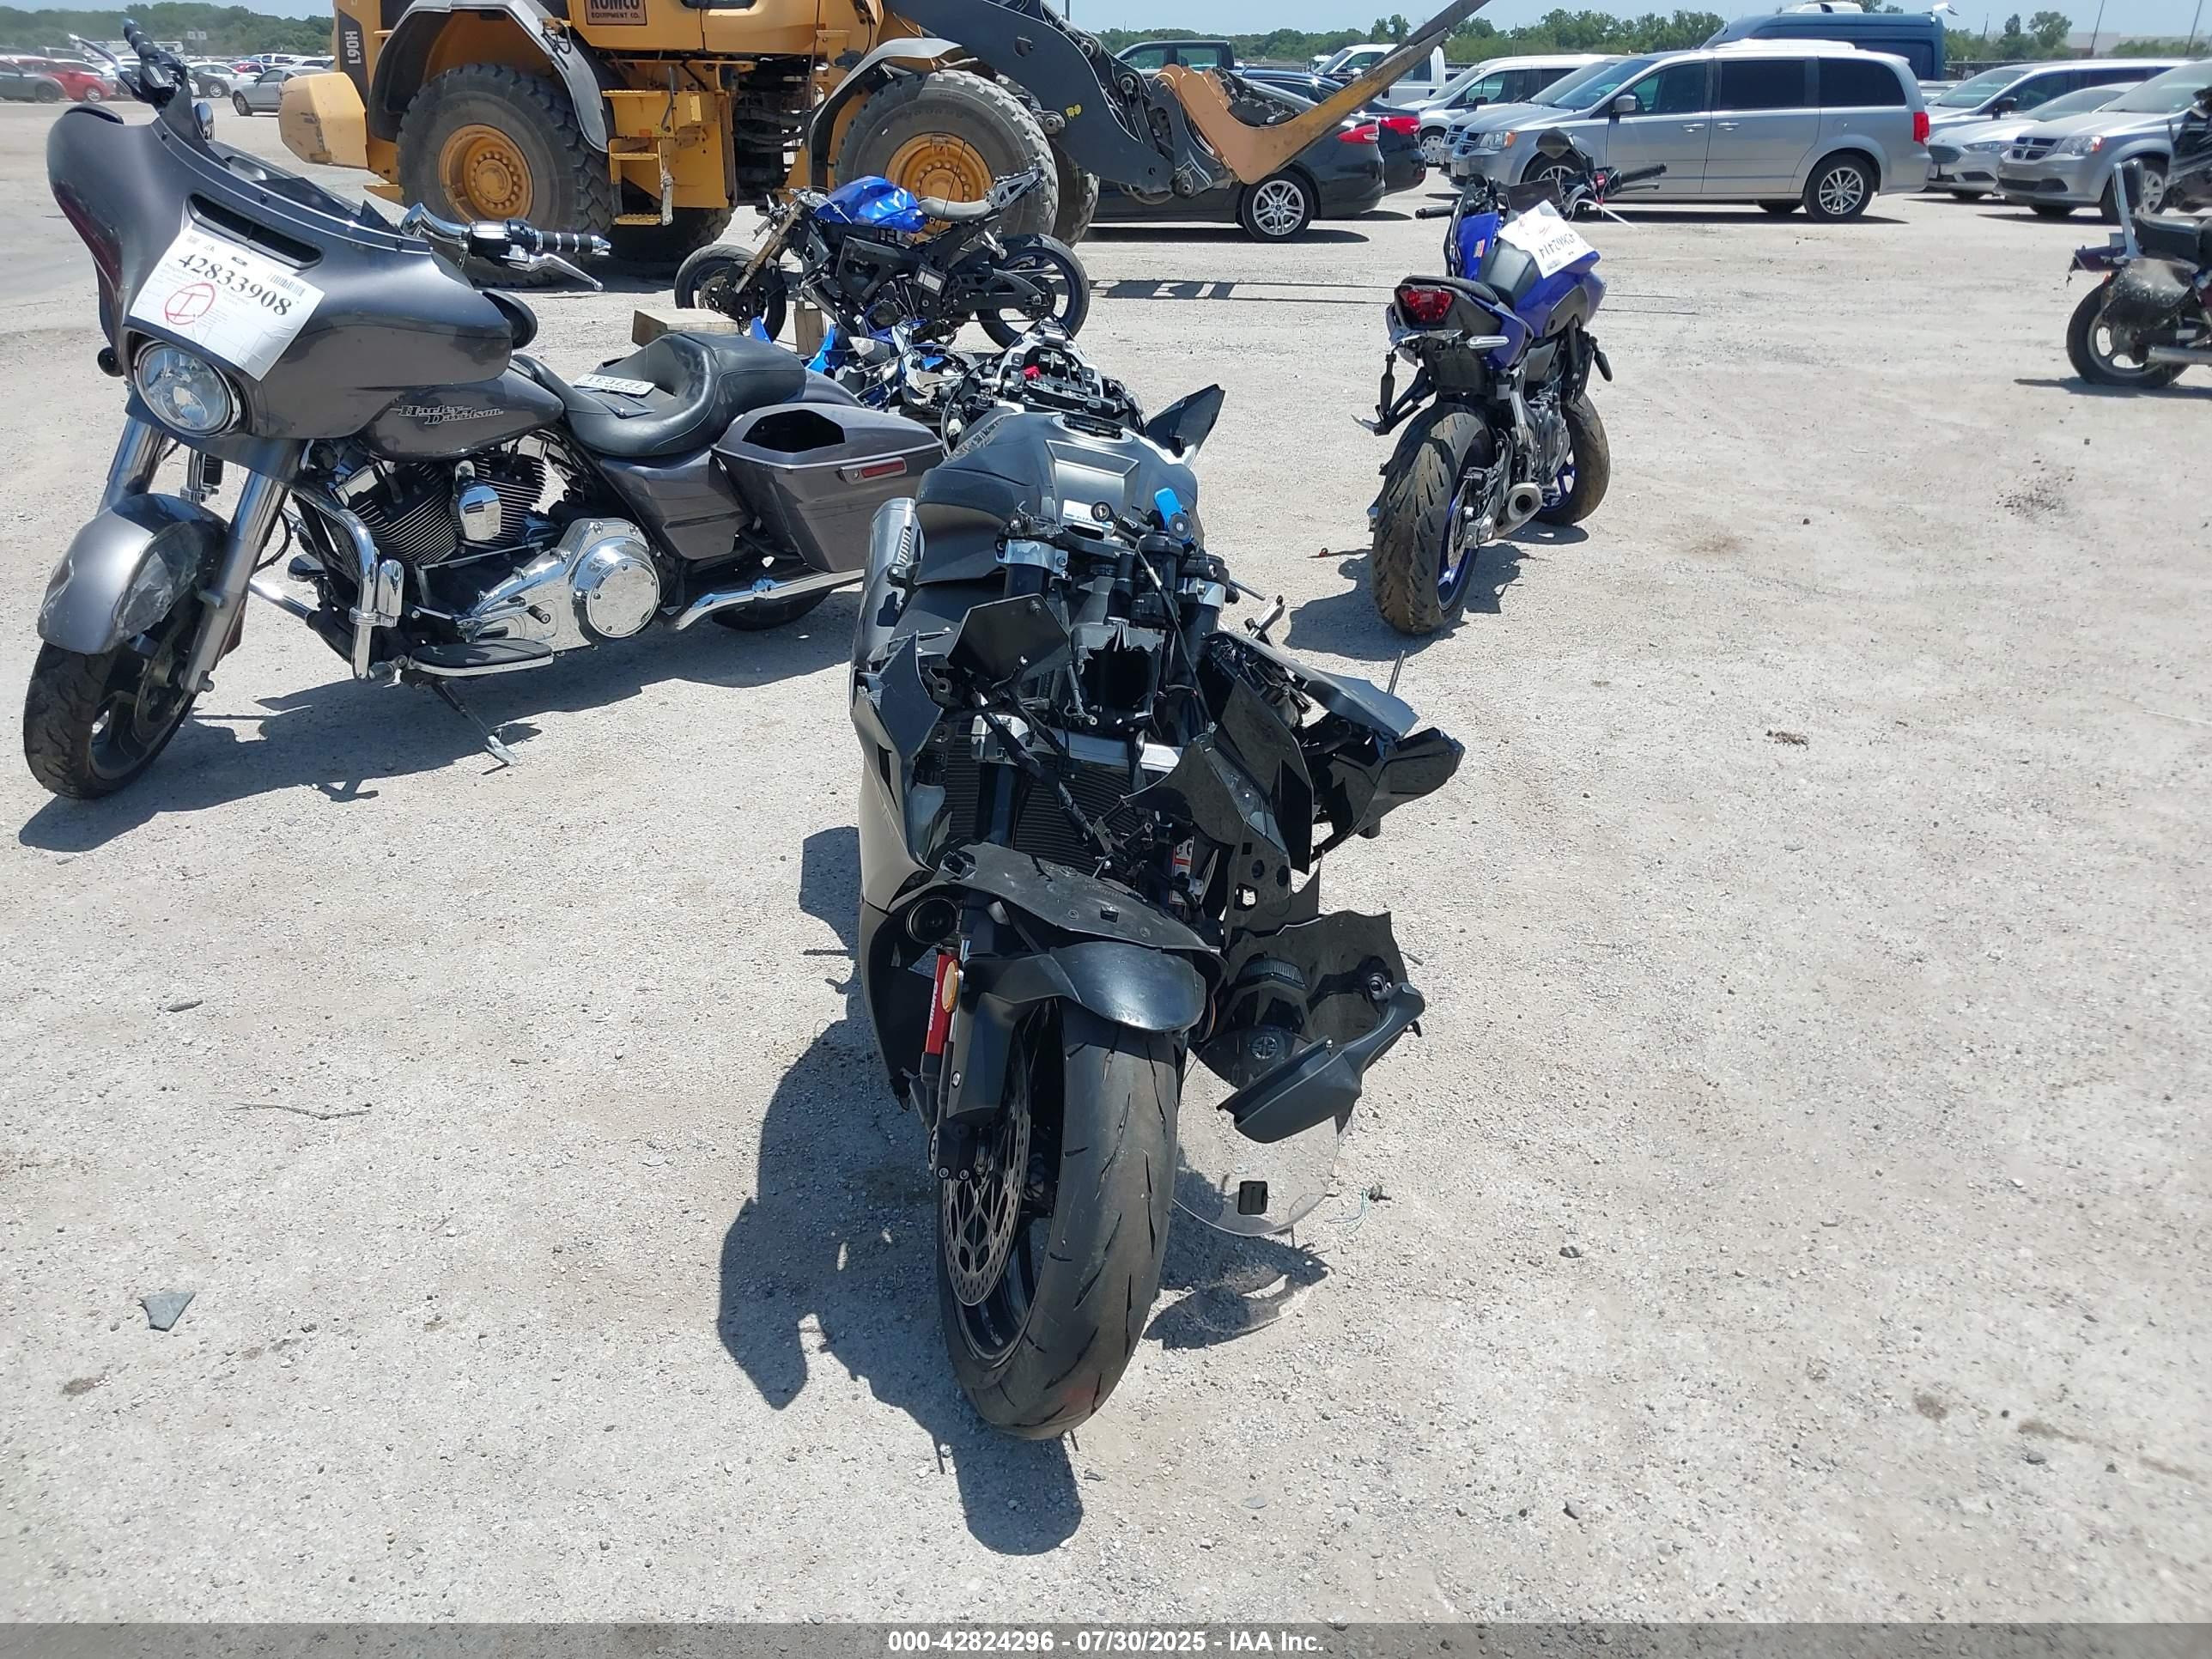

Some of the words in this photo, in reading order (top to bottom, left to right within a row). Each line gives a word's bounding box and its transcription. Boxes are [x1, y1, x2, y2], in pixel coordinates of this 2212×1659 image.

[344, 30, 362, 64] L90H
[178, 253, 293, 316] 42833908
[424, 408, 504, 425] Davidson
